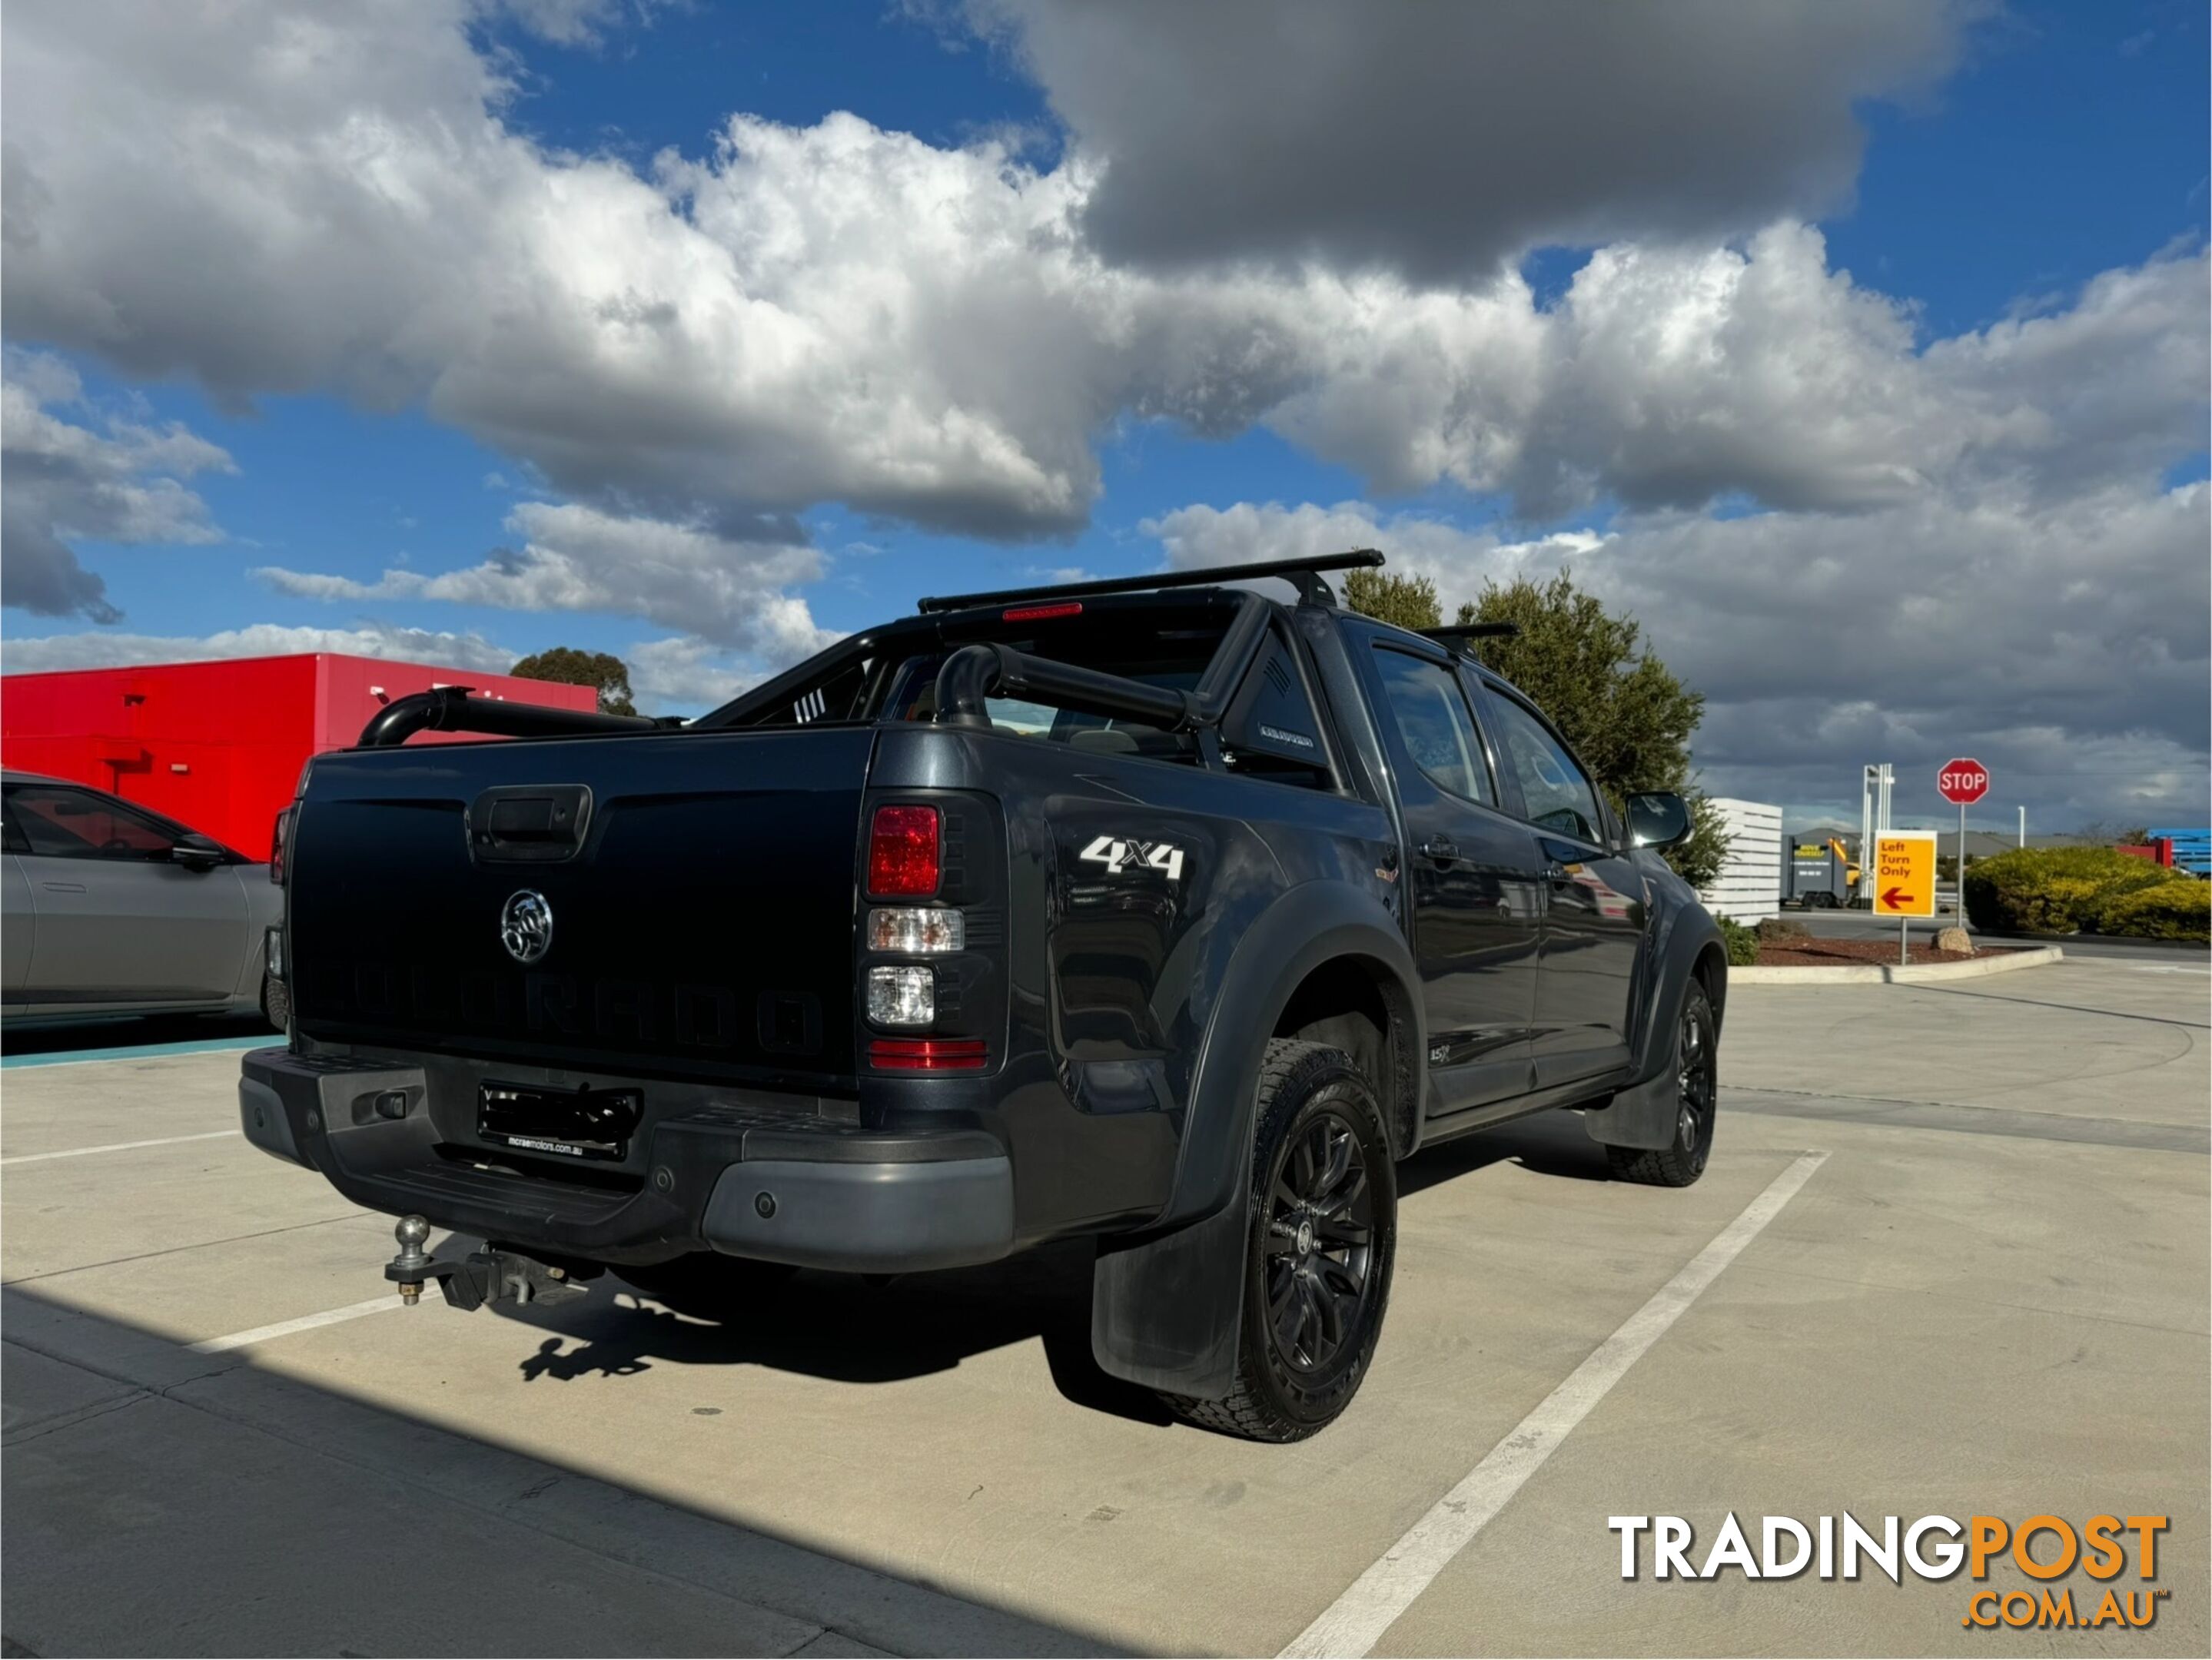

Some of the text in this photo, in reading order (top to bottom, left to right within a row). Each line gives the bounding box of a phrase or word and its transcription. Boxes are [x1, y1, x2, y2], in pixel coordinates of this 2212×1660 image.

[1941, 773, 1985, 790] STOP
[1882, 842, 1905, 852] Left
[1881, 854, 1910, 864] Turn
[1881, 865, 1911, 878] Only
[307, 959, 824, 1056] COLORADO
[508, 1137, 583, 1156] mcraemotors.com.au
